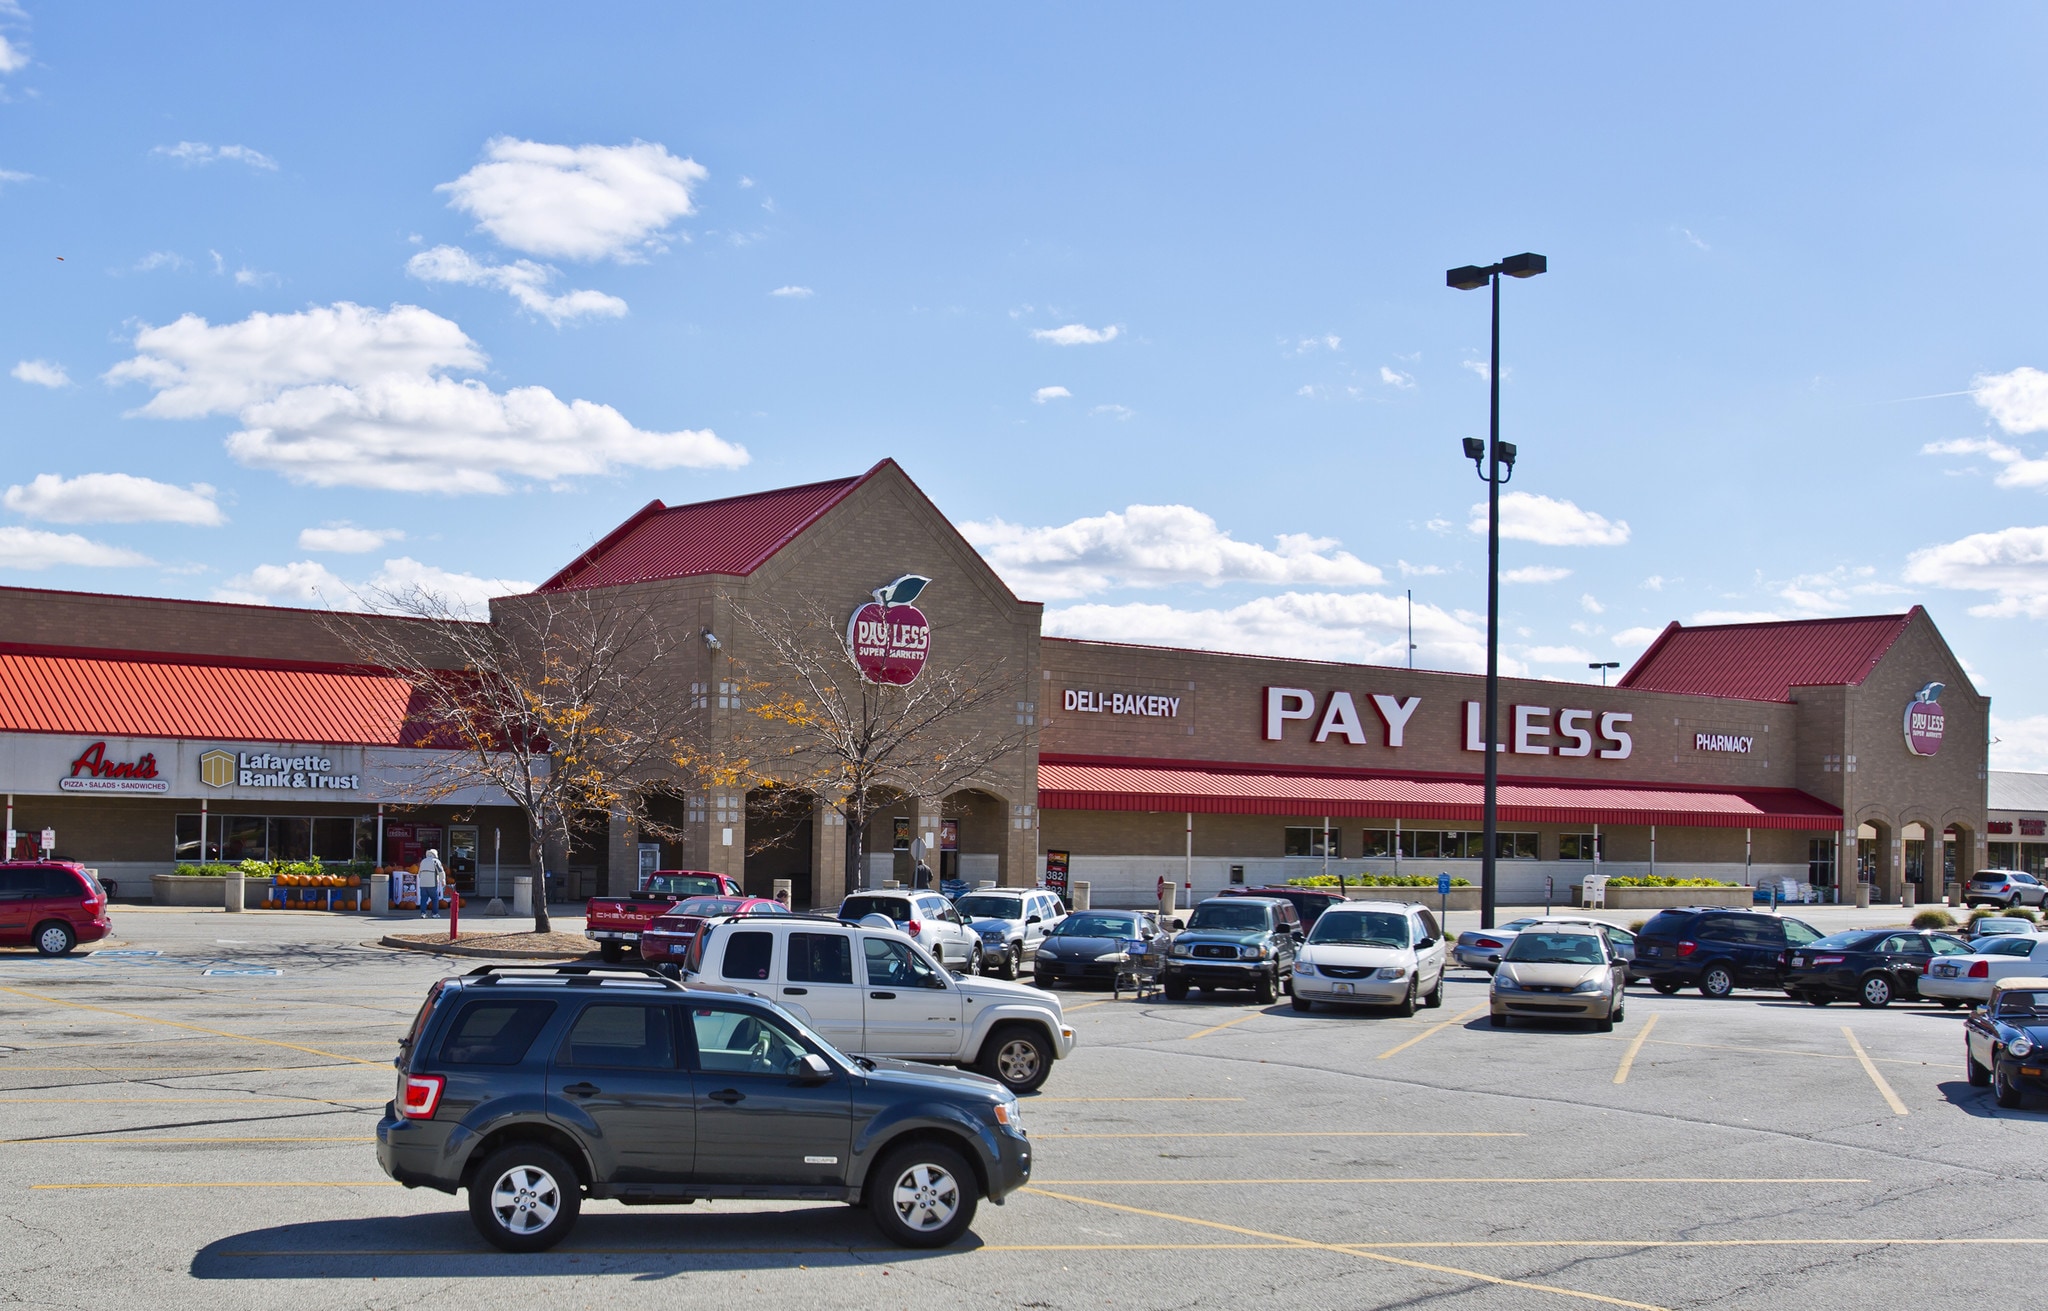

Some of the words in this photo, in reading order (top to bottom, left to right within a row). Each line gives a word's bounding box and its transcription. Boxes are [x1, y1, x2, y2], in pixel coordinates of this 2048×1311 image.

[858, 621, 888, 646] PAY
[892, 624, 928, 649] LESS
[859, 646, 885, 657] SUPER
[1064, 689, 1180, 717] DELI-BAKERY
[1262, 686, 1422, 747] PAY
[1461, 700, 1633, 760] LESS
[1912, 713, 1927, 730] PAY
[1927, 715, 1944, 732] LESS
[1695, 733, 1753, 753] PHARMACY
[70, 741, 159, 779] Arni's
[239, 752, 331, 774] Lafayette
[121, 782, 166, 790] SANDWICHES
